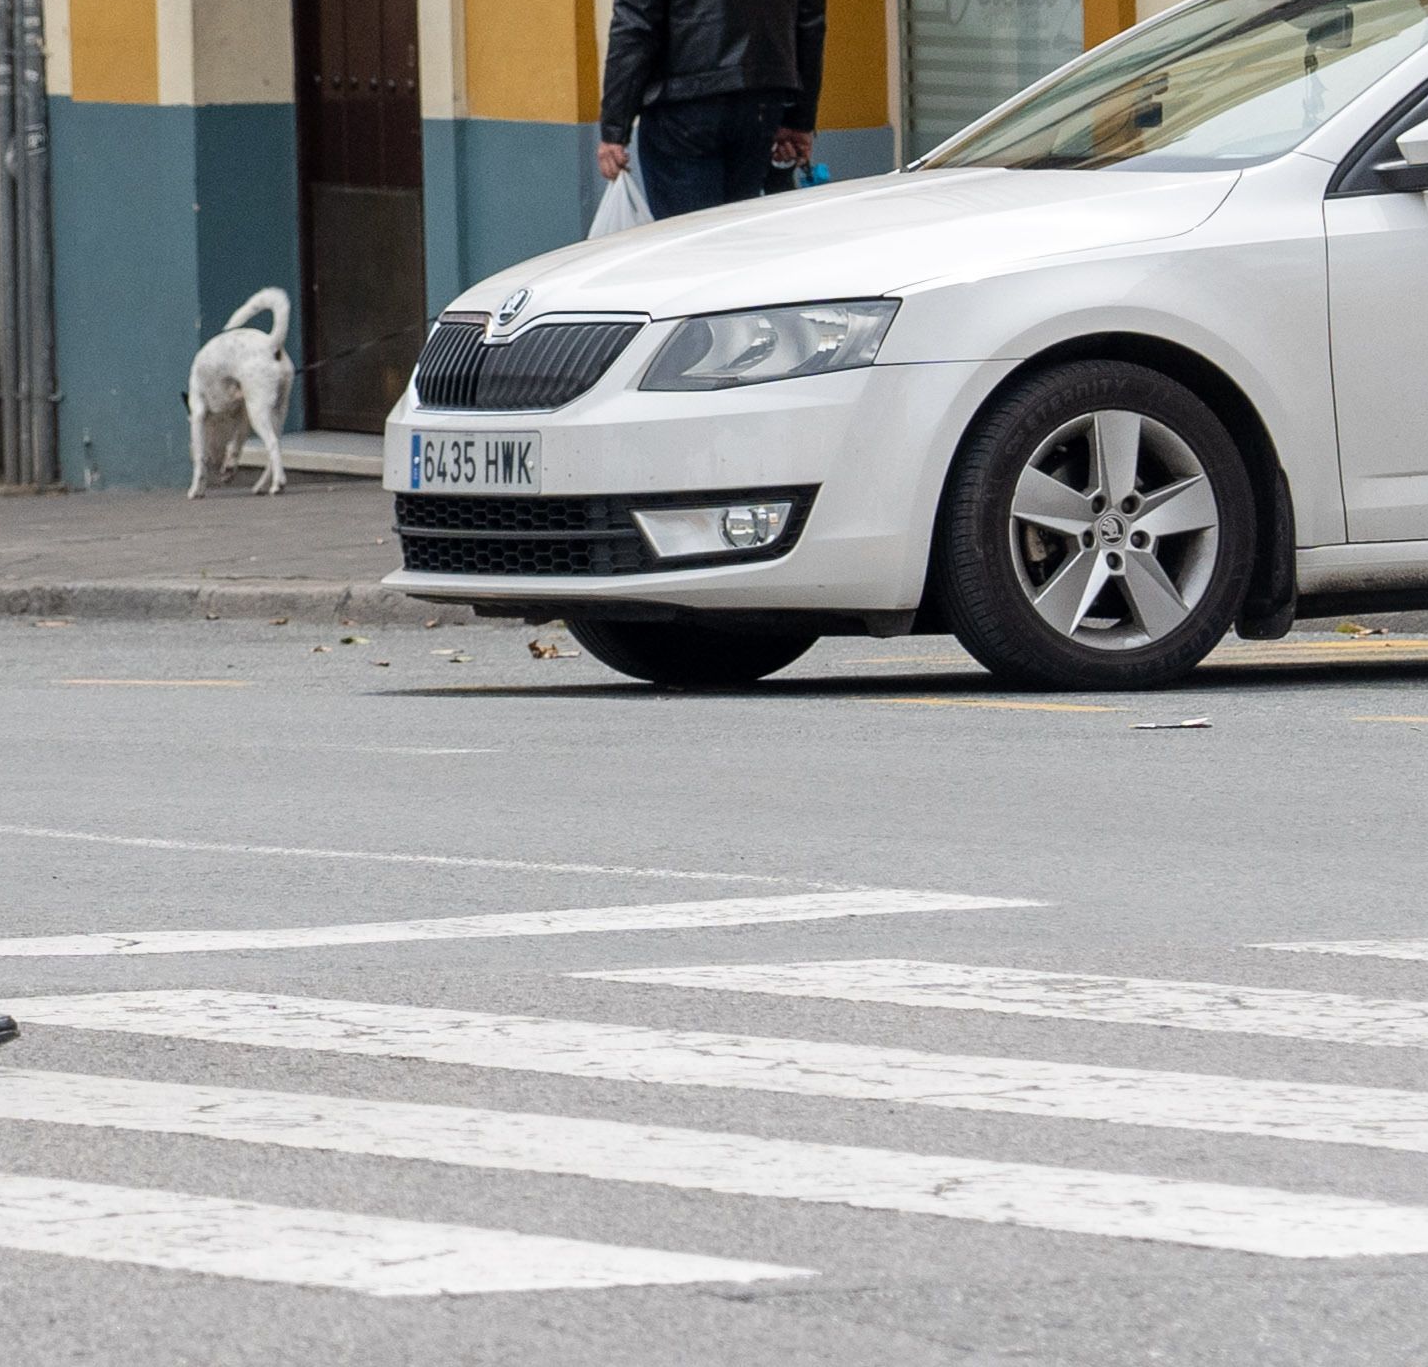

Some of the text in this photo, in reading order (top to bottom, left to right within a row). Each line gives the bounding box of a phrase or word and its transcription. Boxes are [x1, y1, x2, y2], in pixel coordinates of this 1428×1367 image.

[1023, 376, 1129, 434] ETERNITY
[424, 440, 533, 484] 6435 HWK
